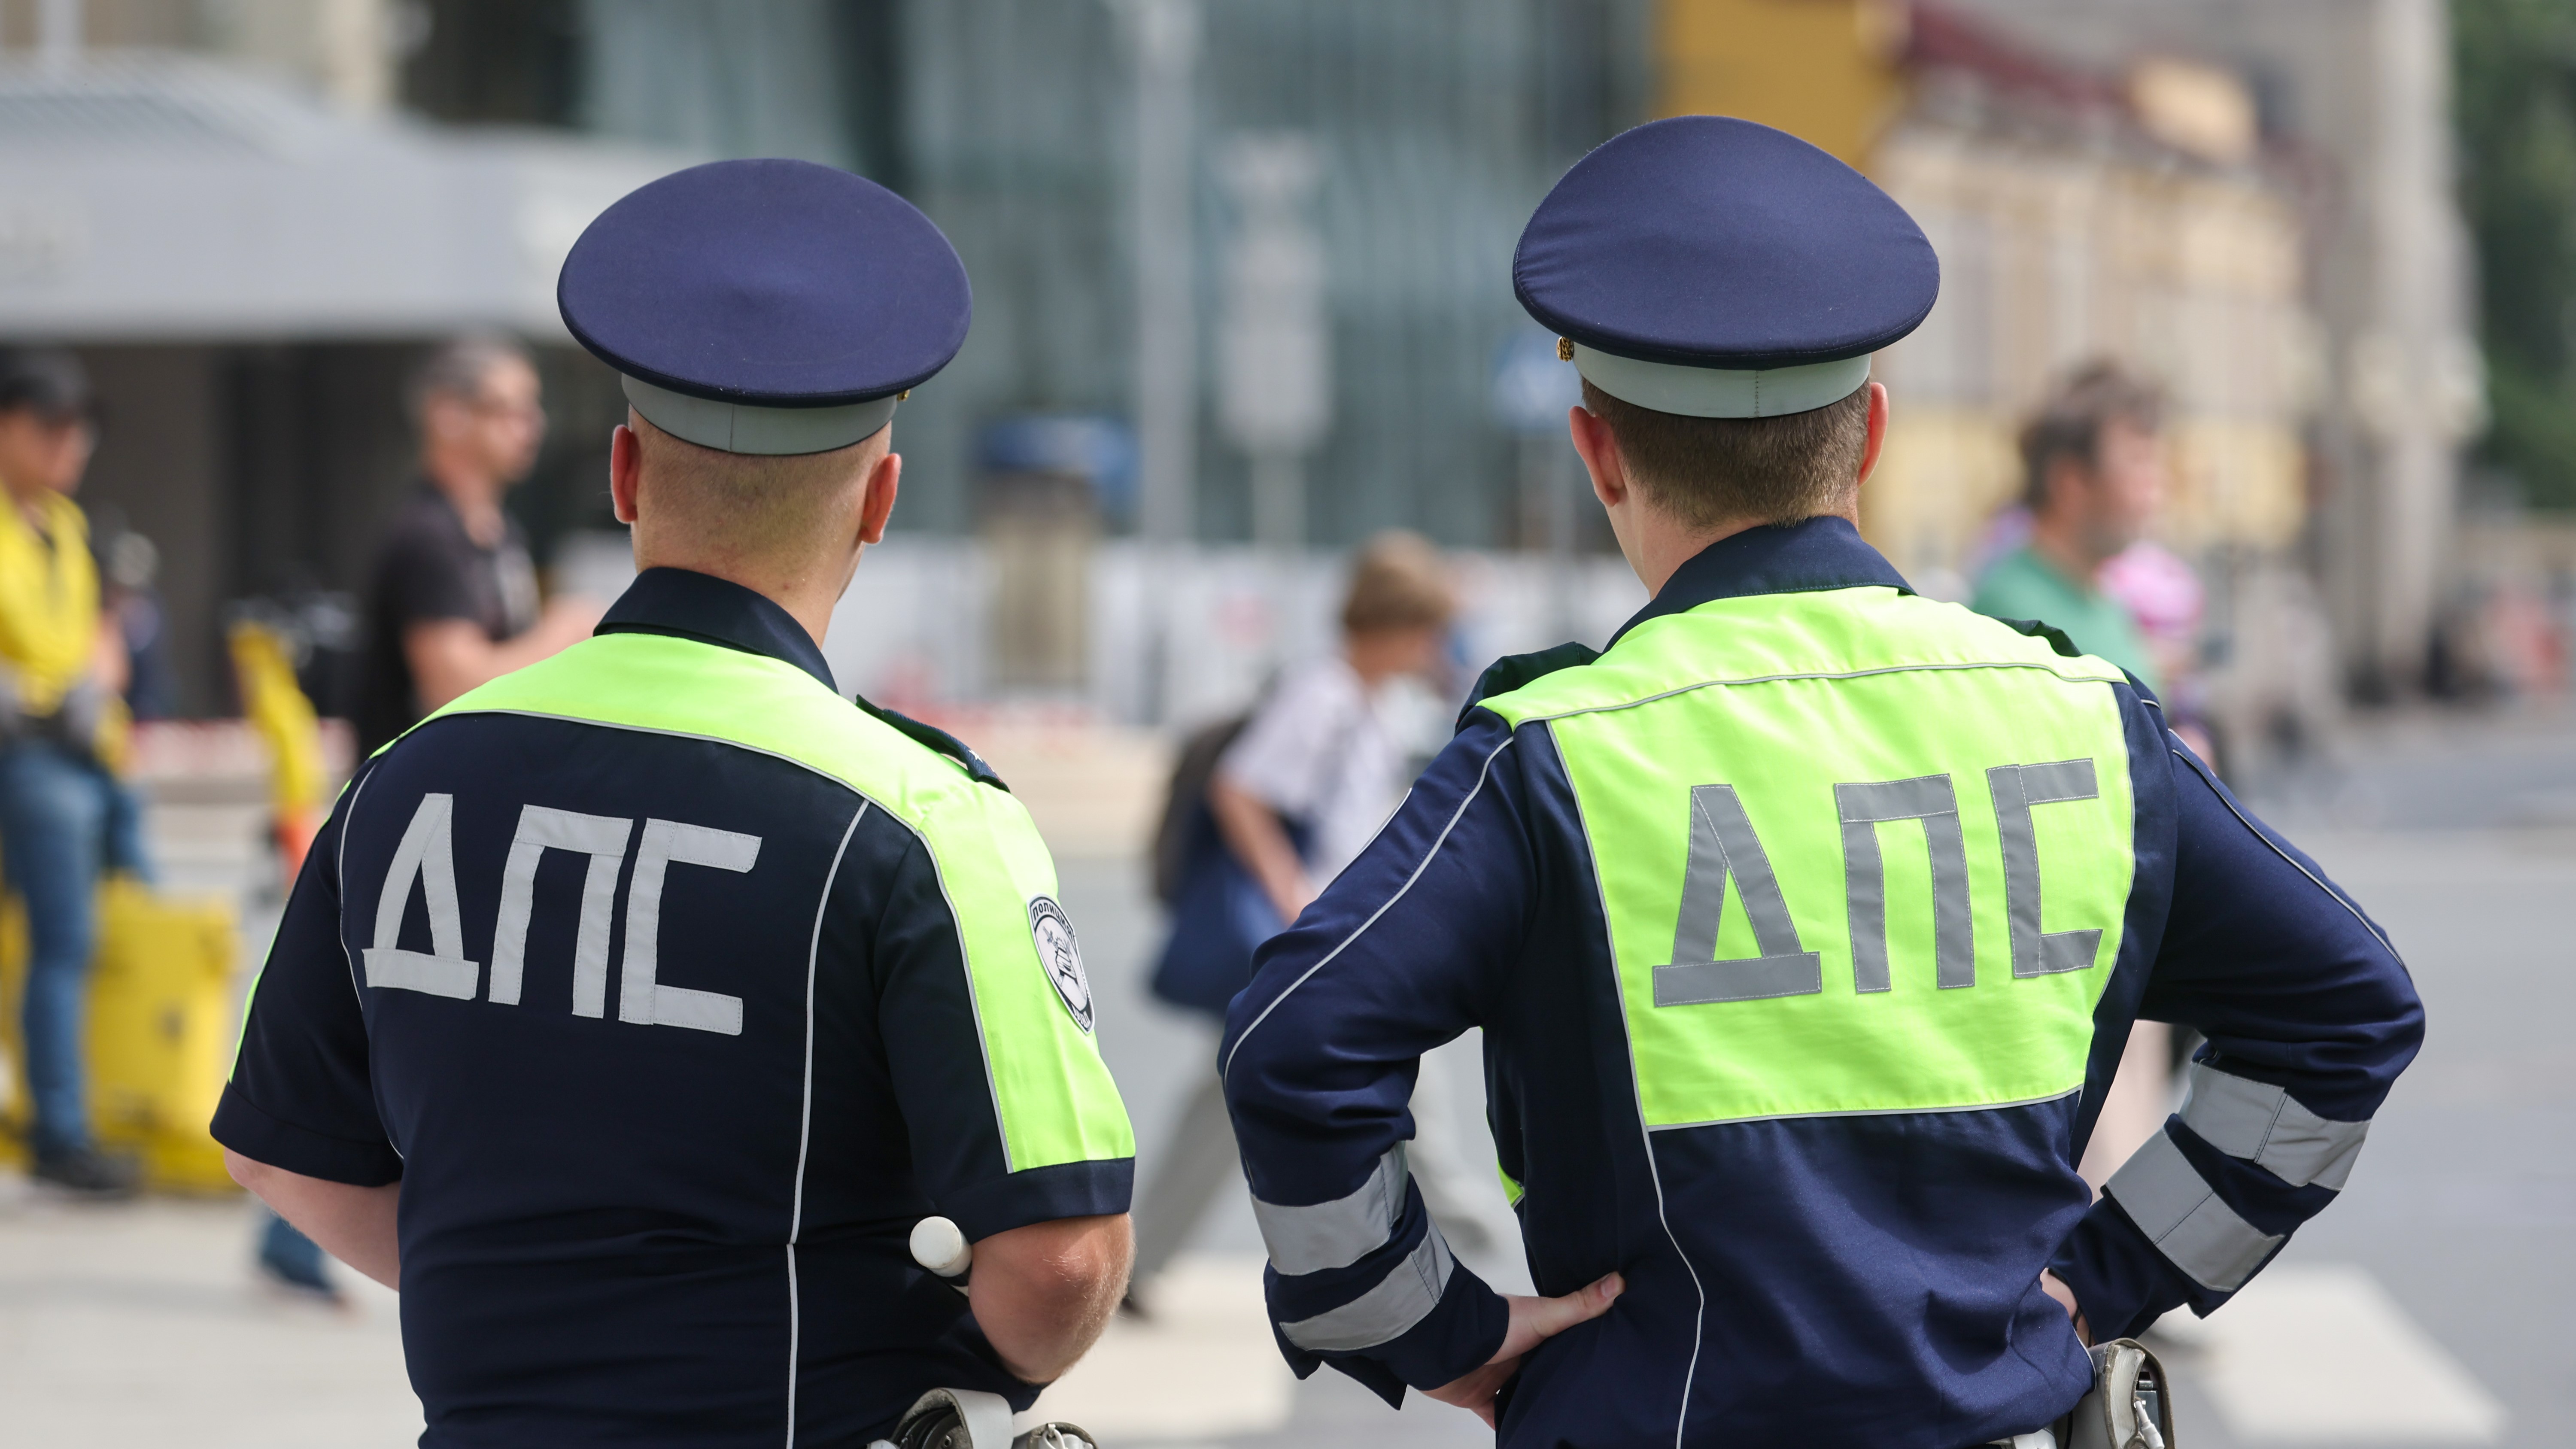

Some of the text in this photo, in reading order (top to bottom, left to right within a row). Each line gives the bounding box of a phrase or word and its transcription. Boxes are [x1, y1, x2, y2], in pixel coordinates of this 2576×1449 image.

[361, 793, 762, 1036] ДПС
[1033, 902, 1073, 942] ПОЛИЦИЯ
[1652, 758, 2102, 1008] ДПС
